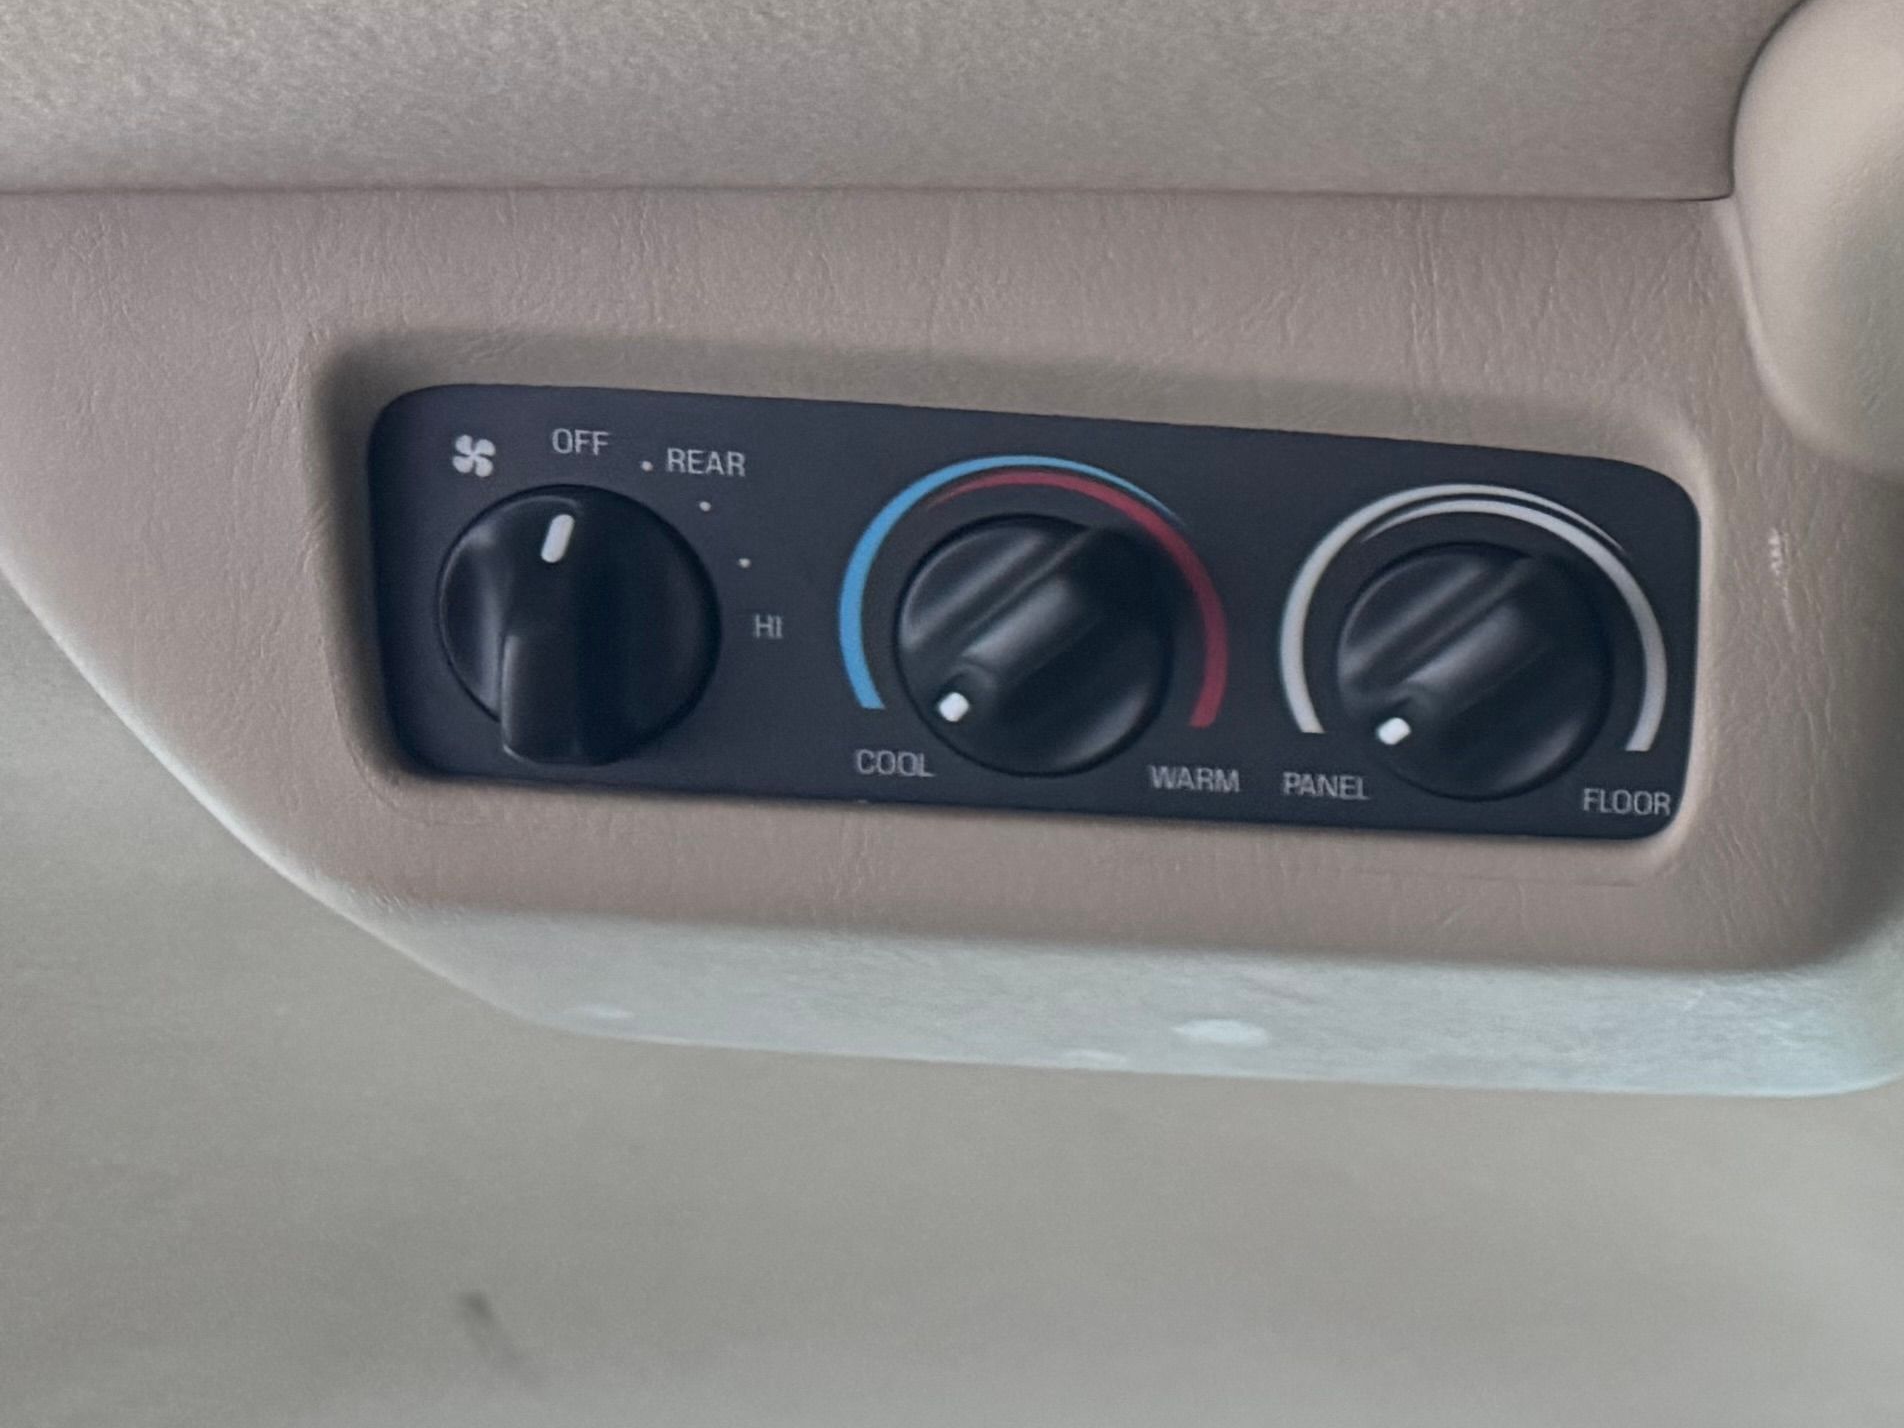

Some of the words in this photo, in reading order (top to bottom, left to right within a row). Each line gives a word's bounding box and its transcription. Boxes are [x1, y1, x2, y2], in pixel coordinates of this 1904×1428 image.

[551, 427, 609, 456] OFF
[666, 447, 746, 477] REAR
[753, 614, 783, 639] HI
[855, 748, 935, 778] COOL
[1149, 765, 1240, 793] WARM
[1282, 771, 1368, 800] PANEL
[1582, 787, 1672, 816] FLOOR
